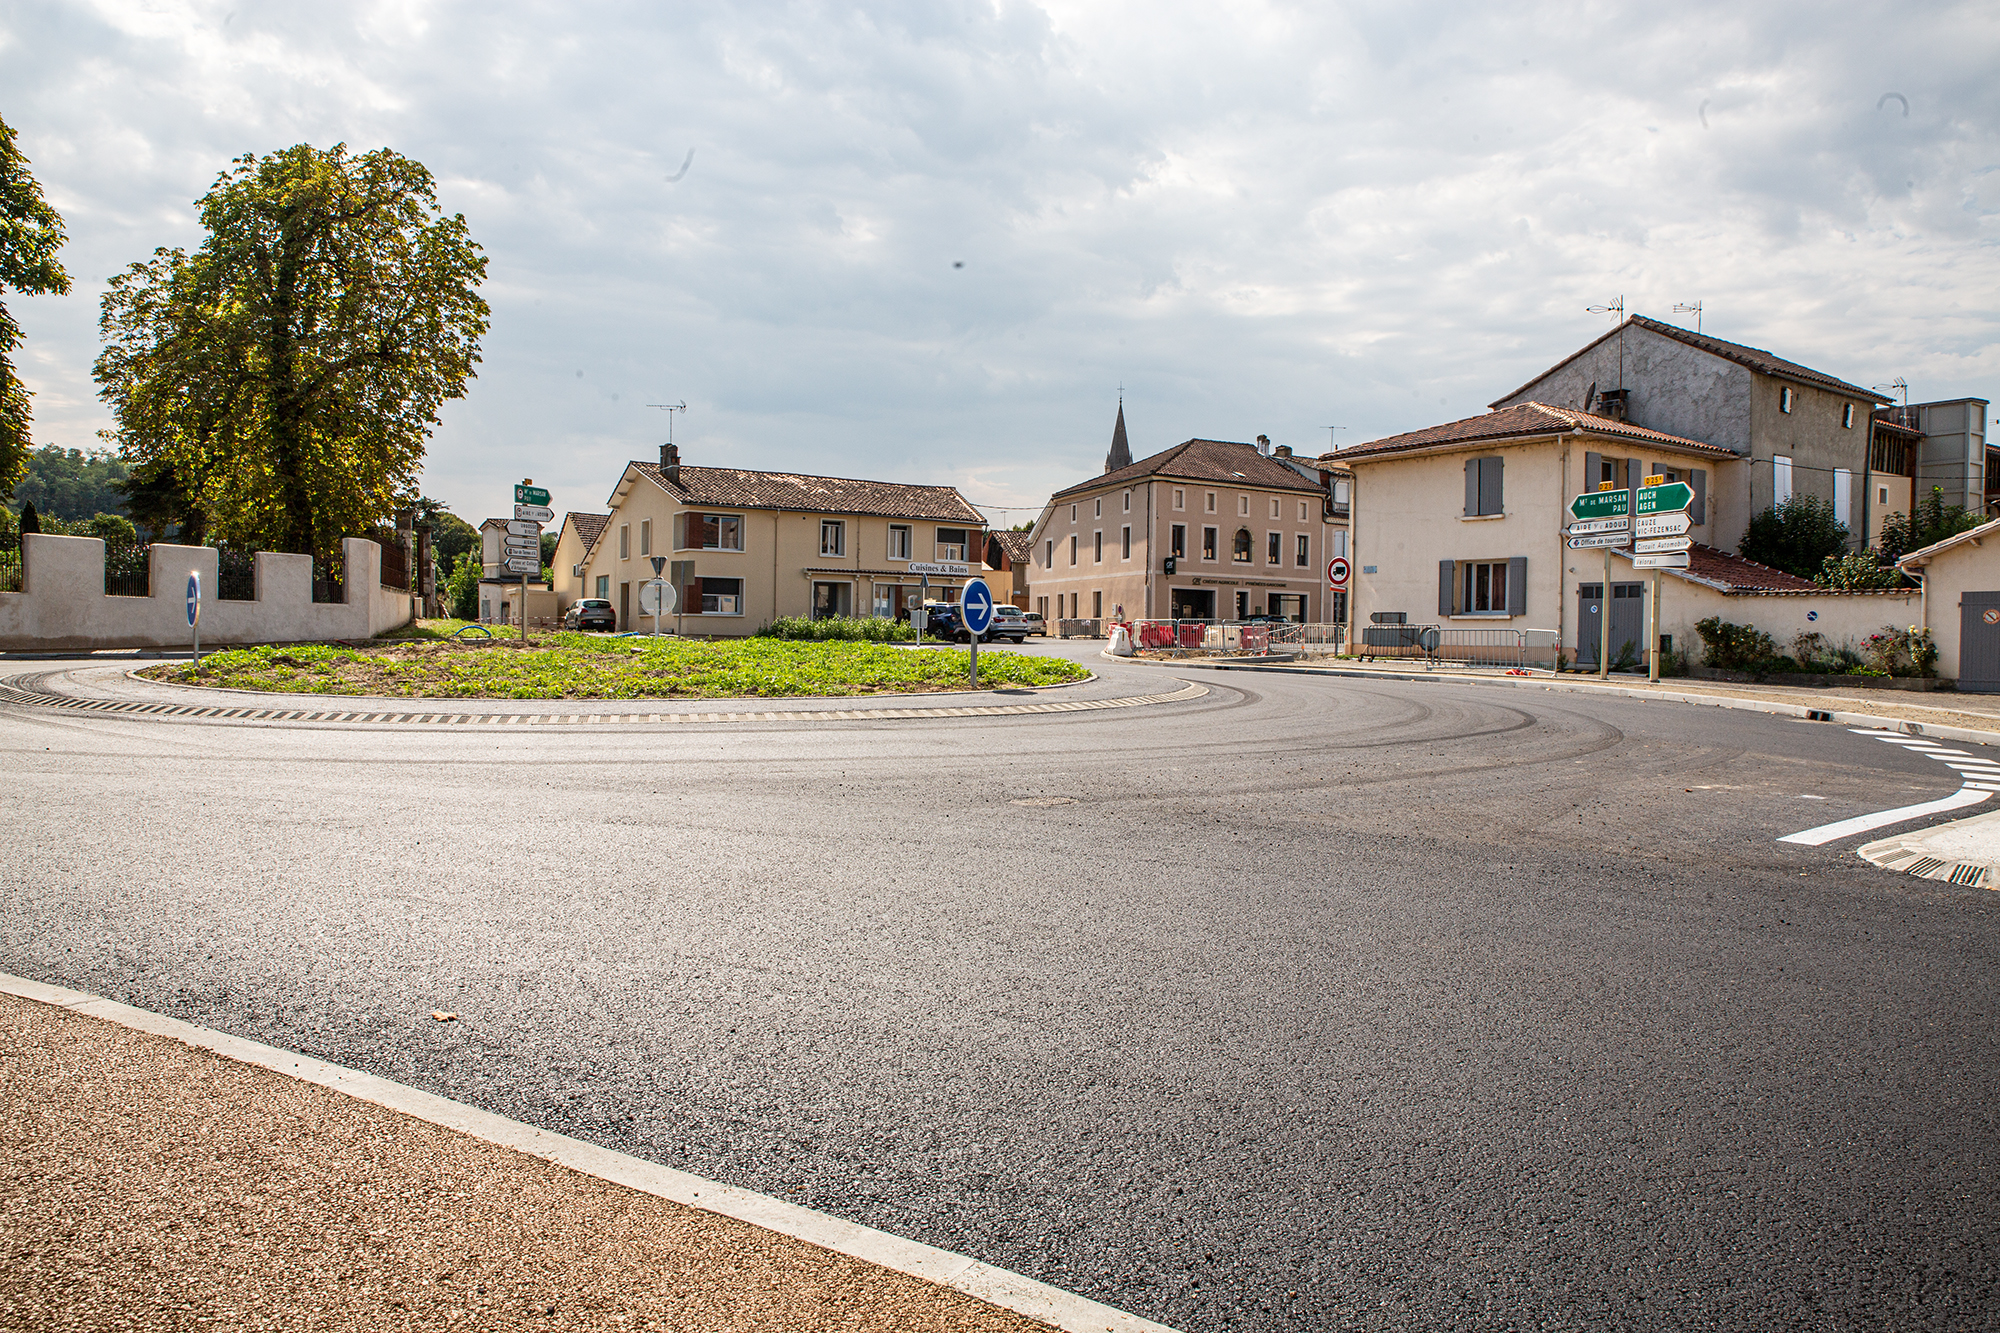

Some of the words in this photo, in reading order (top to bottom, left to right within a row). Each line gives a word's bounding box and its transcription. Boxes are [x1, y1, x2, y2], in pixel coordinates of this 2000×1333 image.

[1598, 494, 1627, 504] MARSAN
[1639, 491, 1657, 500] AUCH
[1613, 504, 1626, 512] PAU
[1639, 502, 1656, 510] AGEN
[1638, 525, 1681, 535] VIC-FEZENSAC
[1658, 540, 1688, 549] Automobile
[910, 563, 938, 572] Cuisines
